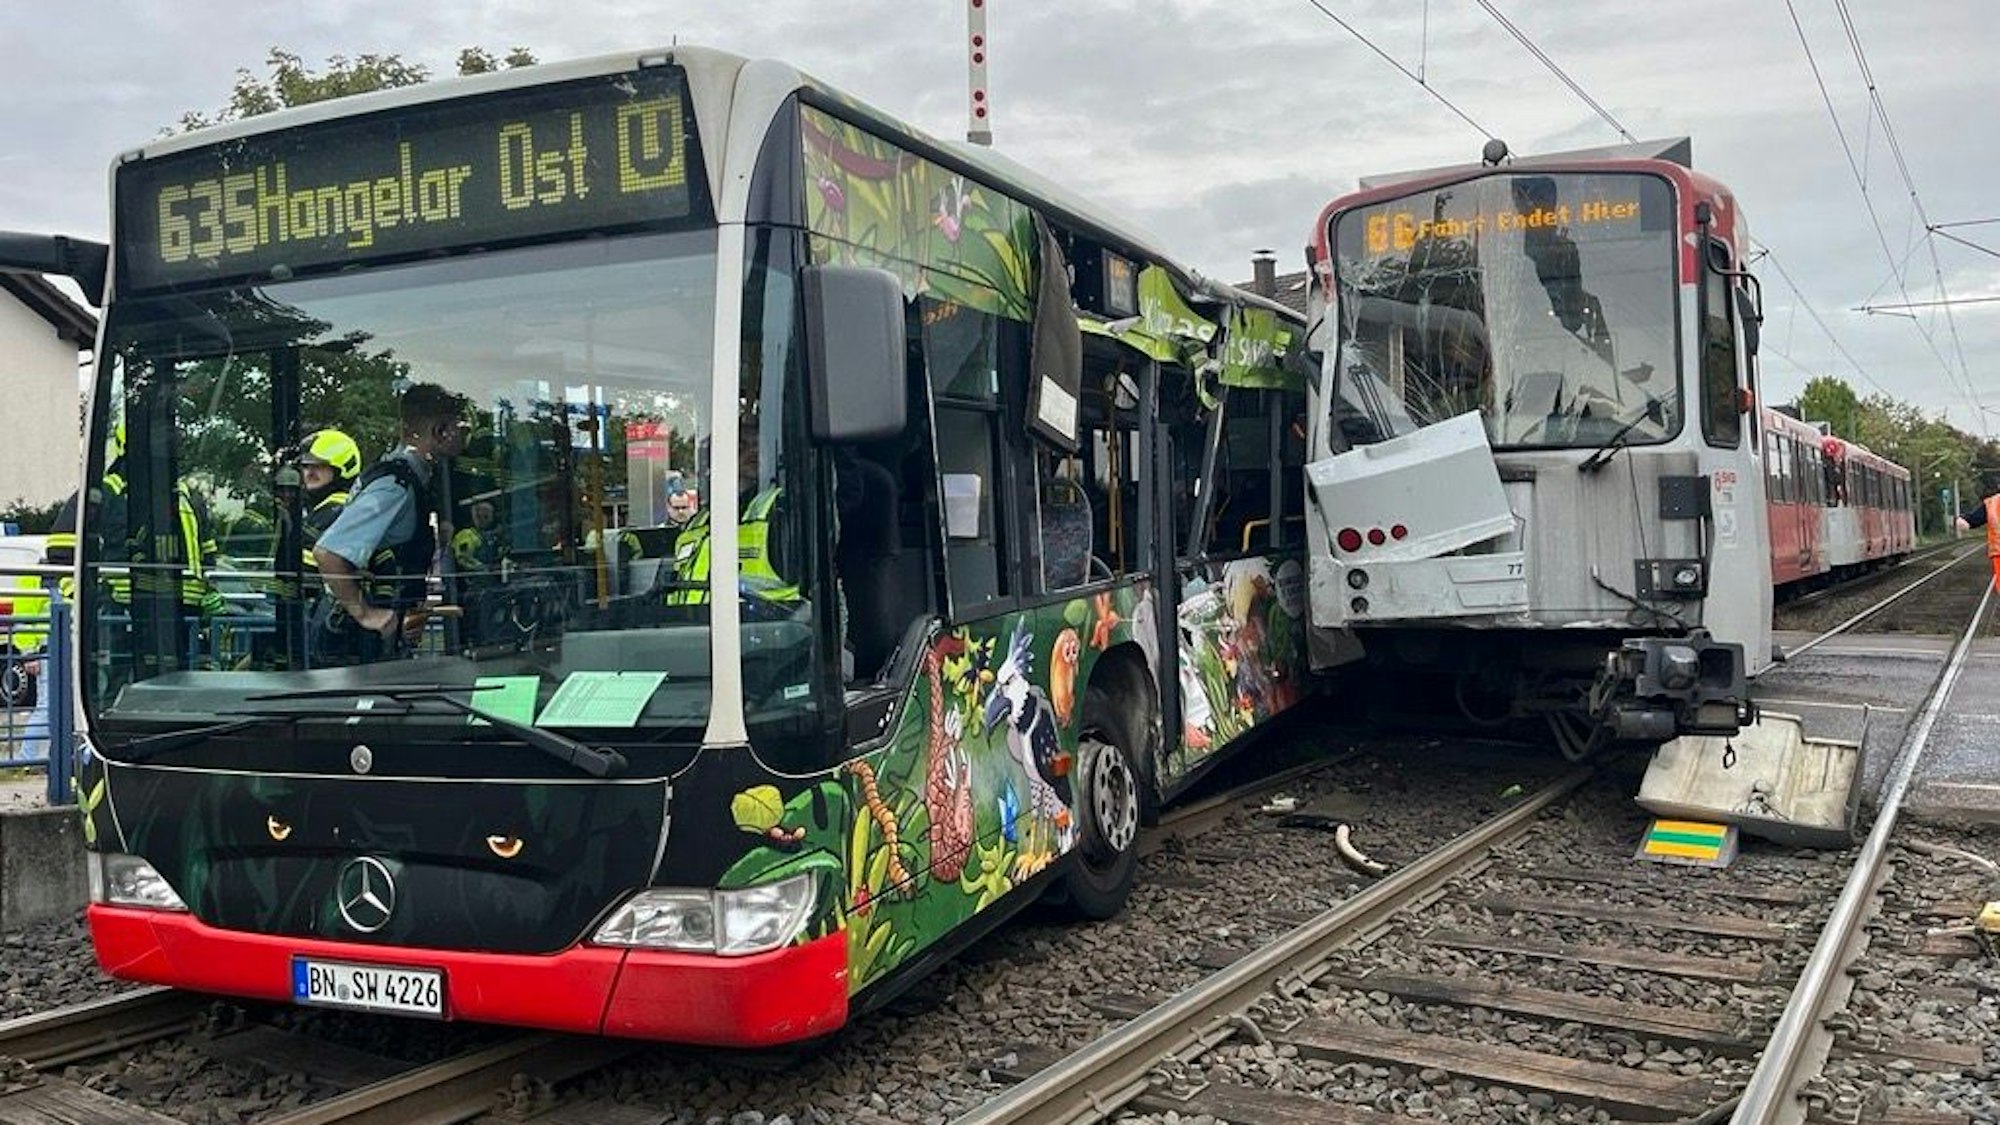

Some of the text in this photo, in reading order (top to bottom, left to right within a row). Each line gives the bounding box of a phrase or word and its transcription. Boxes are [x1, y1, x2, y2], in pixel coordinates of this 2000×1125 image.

[158, 173, 257, 263] 635
[498, 112, 590, 211] Ost
[1497, 206, 1571, 232] Endet
[1580, 200, 1640, 224] Hier
[1506, 562, 1523, 576] 77
[310, 966, 337, 998] BN
[384, 974, 440, 1008] 4226
